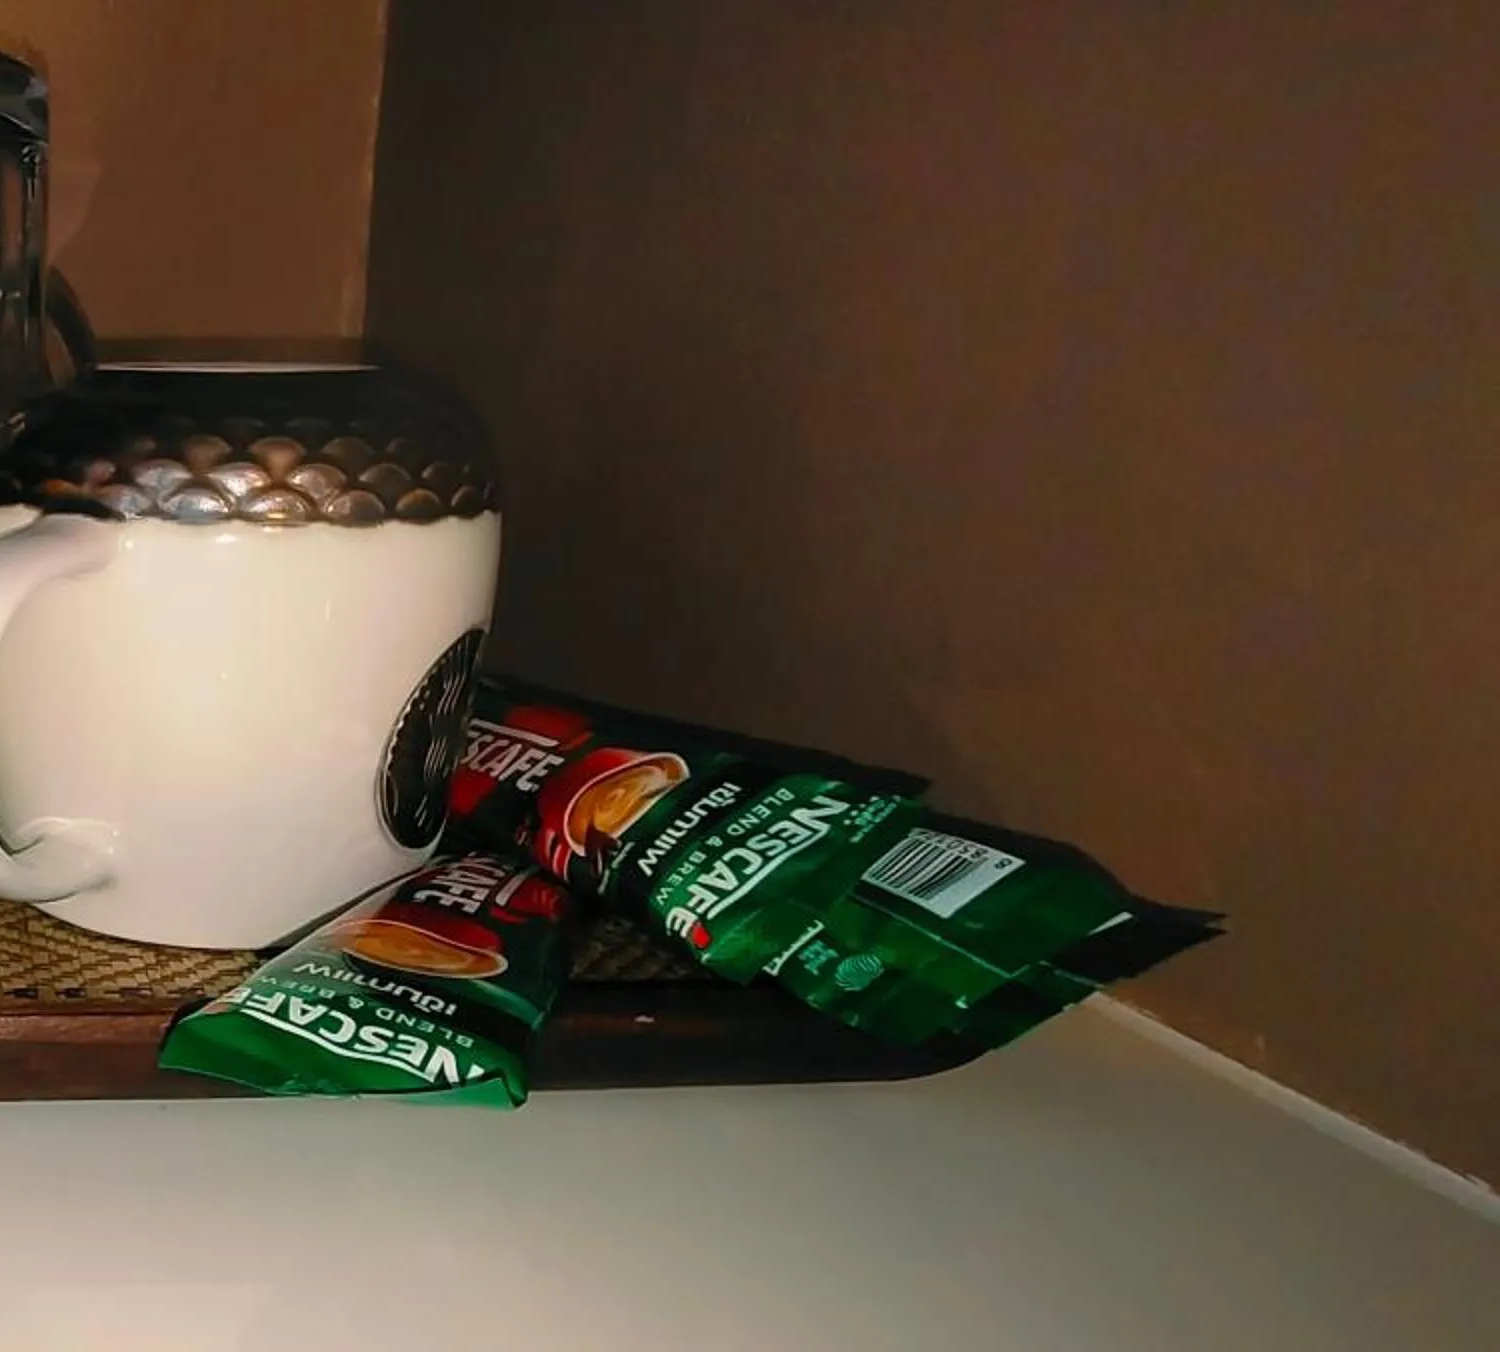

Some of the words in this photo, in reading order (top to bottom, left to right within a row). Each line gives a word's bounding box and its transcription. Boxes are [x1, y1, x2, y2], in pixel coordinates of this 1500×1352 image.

[727, 786, 796, 836] BLEND
[704, 836, 723, 852] &
[654, 854, 704, 907] BREW
[348, 996, 369, 1012] &
[376, 1006, 475, 1050] BLEND
